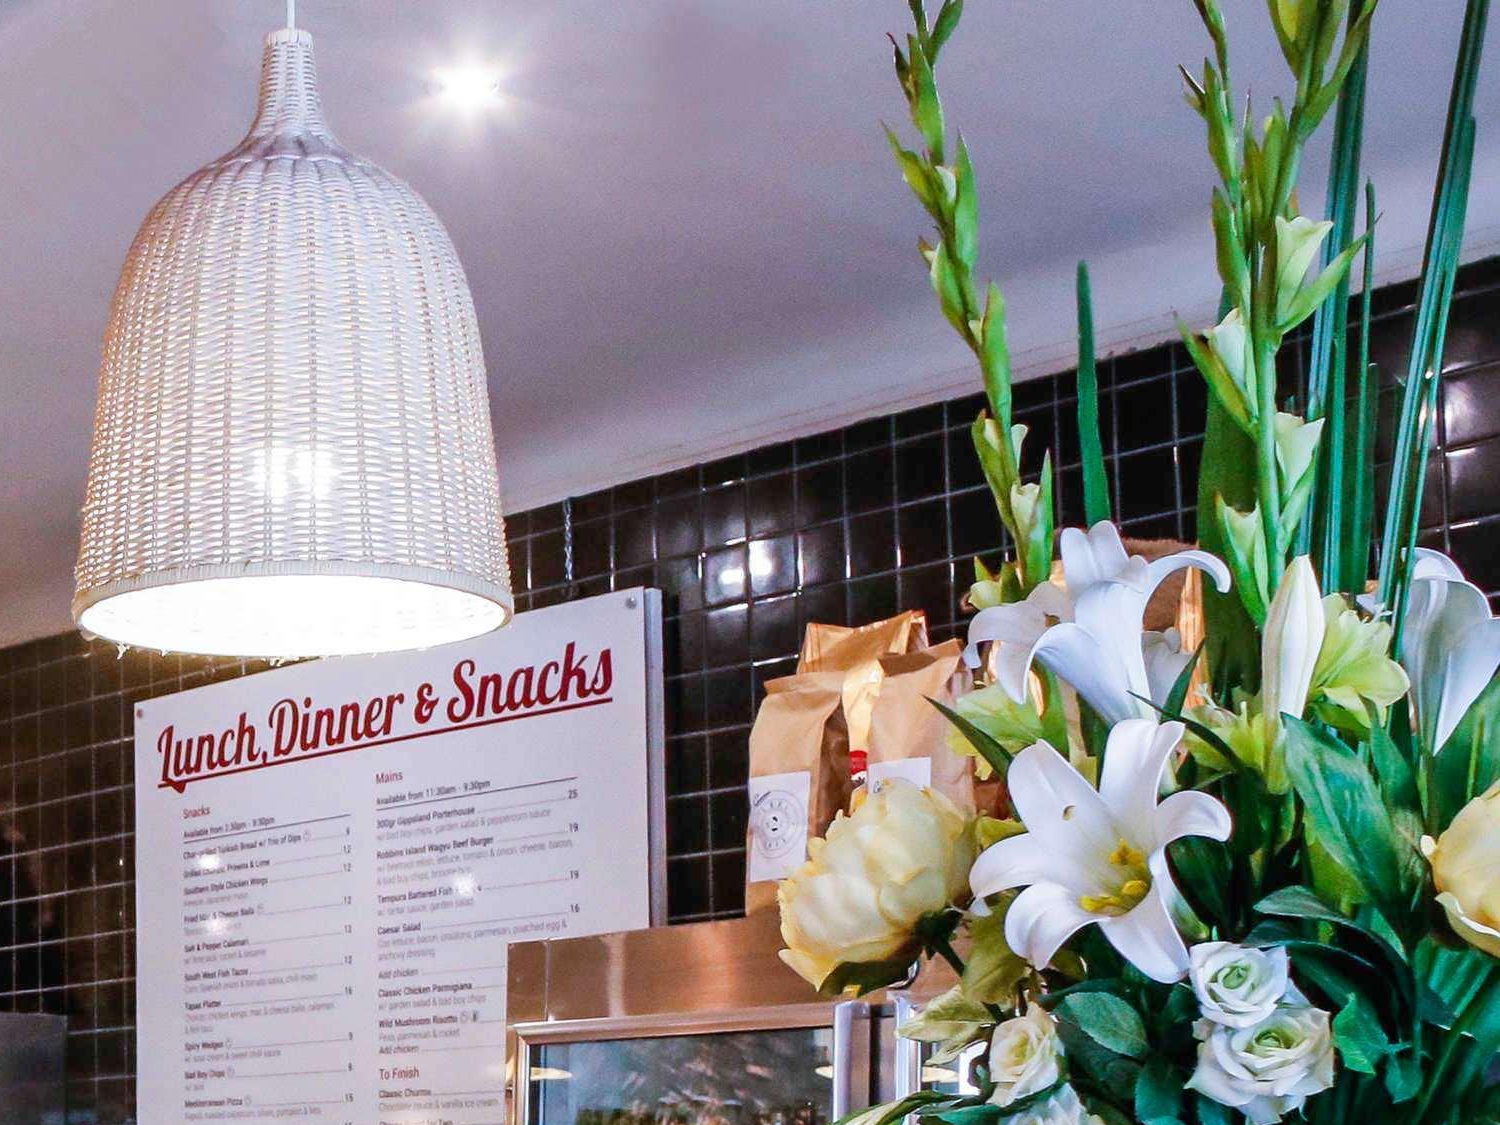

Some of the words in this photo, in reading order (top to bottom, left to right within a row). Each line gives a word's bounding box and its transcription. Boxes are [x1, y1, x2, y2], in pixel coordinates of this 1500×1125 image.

[157, 711, 268, 783] Lunch,
[269, 693, 404, 757] Dinner
[414, 683, 439, 724] &
[447, 640, 614, 722] Snacks
[376, 772, 402, 784] Mains
[408, 790, 423, 800] from
[433, 807, 474, 820] Porterhouse
[568, 790, 578, 799] 25
[183, 806, 210, 819] Snacks
[210, 825, 223, 833] from
[406, 845, 426, 855] Island
[428, 842, 450, 853] Wagyu
[453, 840, 468, 849] Beef
[470, 837, 493, 847] Burger
[569, 823, 578, 832] 19
[211, 882, 224, 893] Style
[226, 880, 248, 890] Chicken
[408, 889, 437, 900] Battered
[439, 887, 453, 896] Fish
[570, 871, 578, 879] 19
[378, 925, 400, 935] Caesar
[402, 922, 421, 932] Salad
[185, 973, 200, 981] South
[378, 970, 391, 979] Add
[393, 969, 418, 978] chicken
[378, 988, 401, 997] Classic
[404, 986, 430, 995] Chicken
[379, 1019, 392, 1028] Wild
[395, 1017, 431, 1027] Mushroom
[380, 1068, 390, 1080] To
[392, 1067, 419, 1079] Finish
[227, 1098, 242, 1106] Pizza
